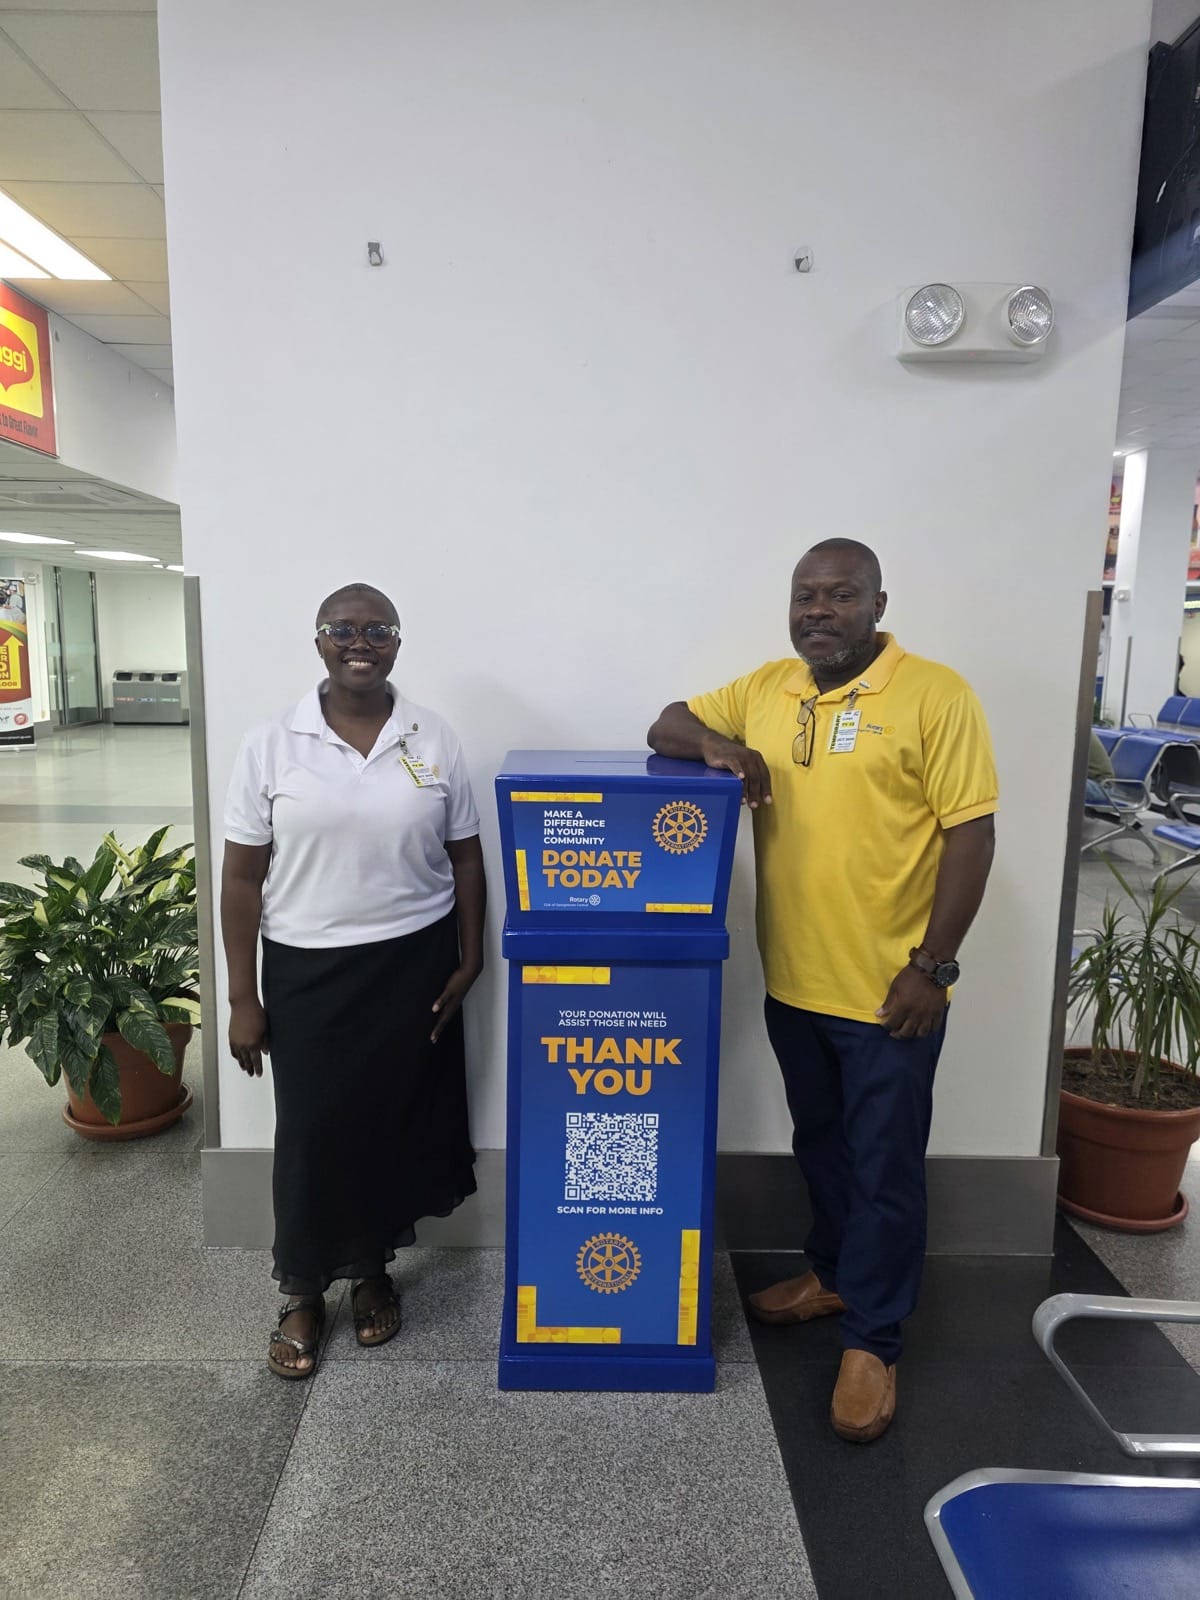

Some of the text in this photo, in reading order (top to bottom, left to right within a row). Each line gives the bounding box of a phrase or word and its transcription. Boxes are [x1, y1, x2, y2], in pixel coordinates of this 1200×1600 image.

[543, 810, 583, 818] MAKE A
[543, 819, 606, 828] DIFFERENCE
[543, 828, 585, 837] IN YOUR
[543, 837, 605, 846] COMMUNITY
[542, 849, 642, 868] DONATE
[542, 869, 641, 889] TODAY
[558, 1010, 667, 1020] YOUR DONATION WILL
[558, 1019, 667, 1028] ASSIST THOSE IN NEED
[540, 1037, 682, 1065] THANK
[567, 1068, 652, 1096] YOU
[557, 1206, 664, 1216] SCAN FOR MORE INFO
